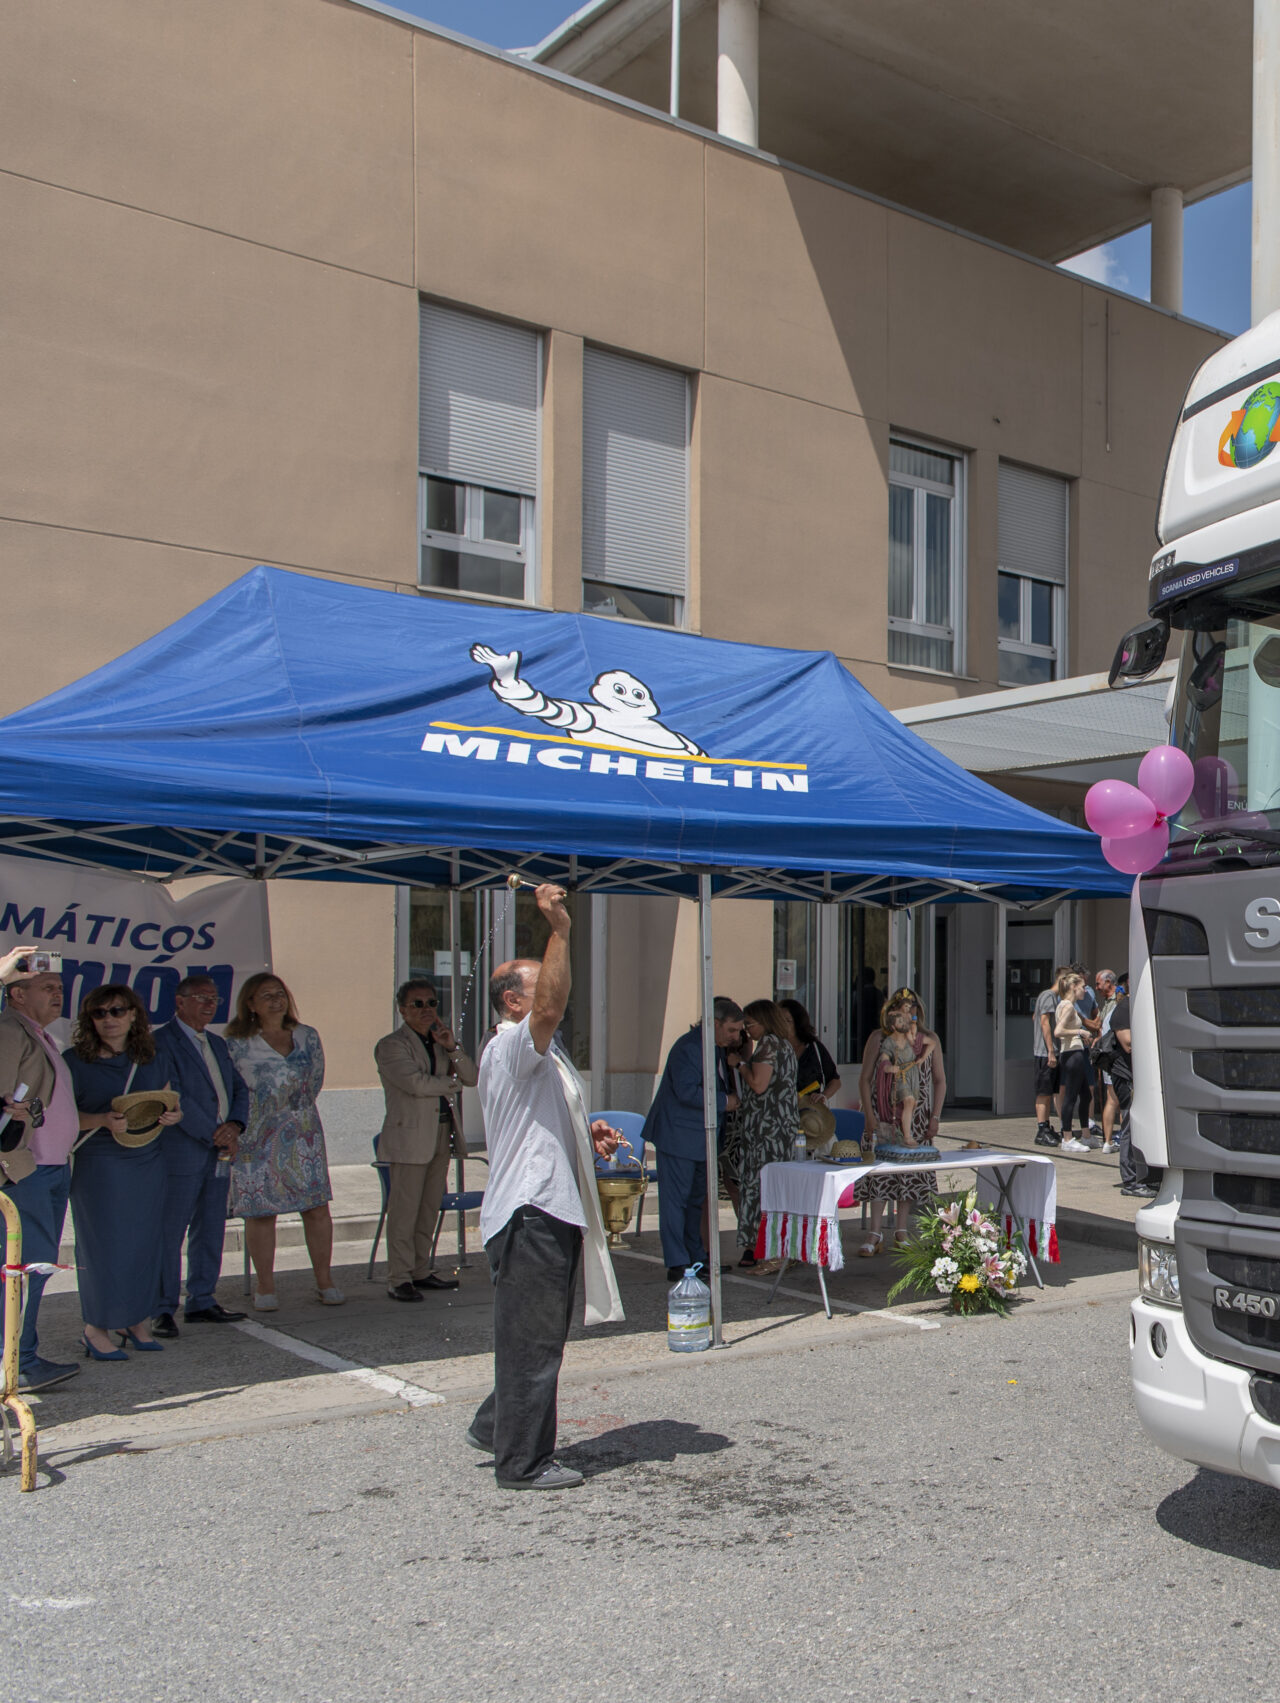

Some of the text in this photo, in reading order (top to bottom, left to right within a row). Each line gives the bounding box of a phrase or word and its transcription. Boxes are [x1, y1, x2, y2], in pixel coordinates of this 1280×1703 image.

[1161, 563, 1235, 595] SCANIA USED VEHICLES
[421, 732, 809, 793] MICHELIN
[1227, 799, 1248, 811] ENÚ
[0, 902, 216, 951] MÁTICOS
[61, 954, 234, 1025] nión
[1215, 1288, 1276, 1318] R 450
